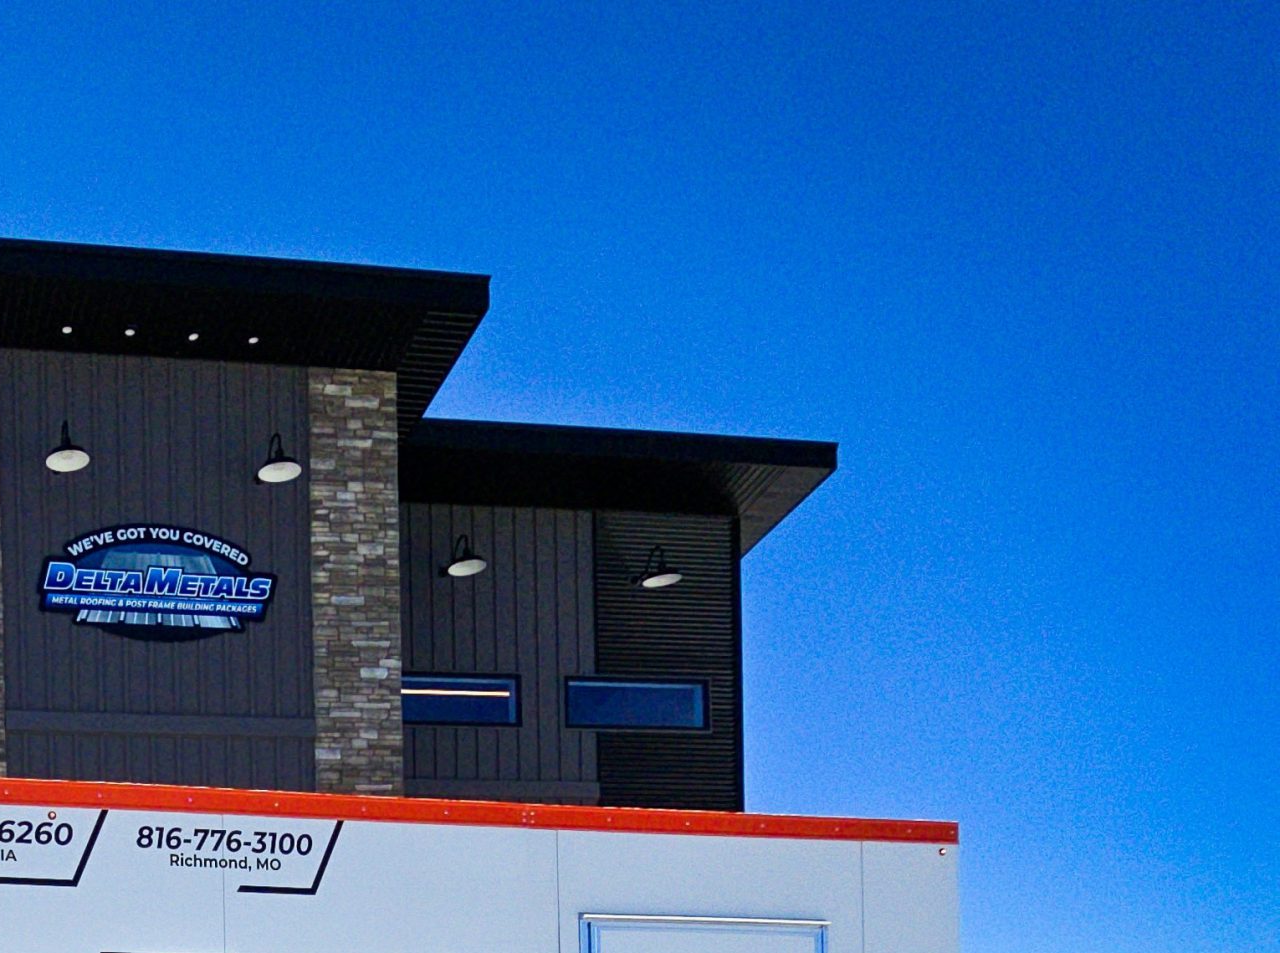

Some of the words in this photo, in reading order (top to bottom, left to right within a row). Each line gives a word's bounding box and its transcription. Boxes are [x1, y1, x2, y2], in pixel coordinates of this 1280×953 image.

[67, 531, 115, 557] WE'VE
[116, 528, 146, 541] GOT
[149, 528, 180, 541] YOU
[183, 532, 249, 567] COVERED
[51, 596, 78, 605] METAL
[80, 597, 117, 607] ROOFING
[117, 599, 124, 607] &
[125, 600, 147, 608] POST
[148, 601, 176, 610] FRAME
[177, 602, 215, 611] BUILDING
[216, 604, 257, 613] PACKAGES
[135, 825, 313, 856] 816-776-3100
[0, 849, 18, 862] IA
[169, 853, 252, 872] Richmond,
[256, 857, 282, 871] MO
